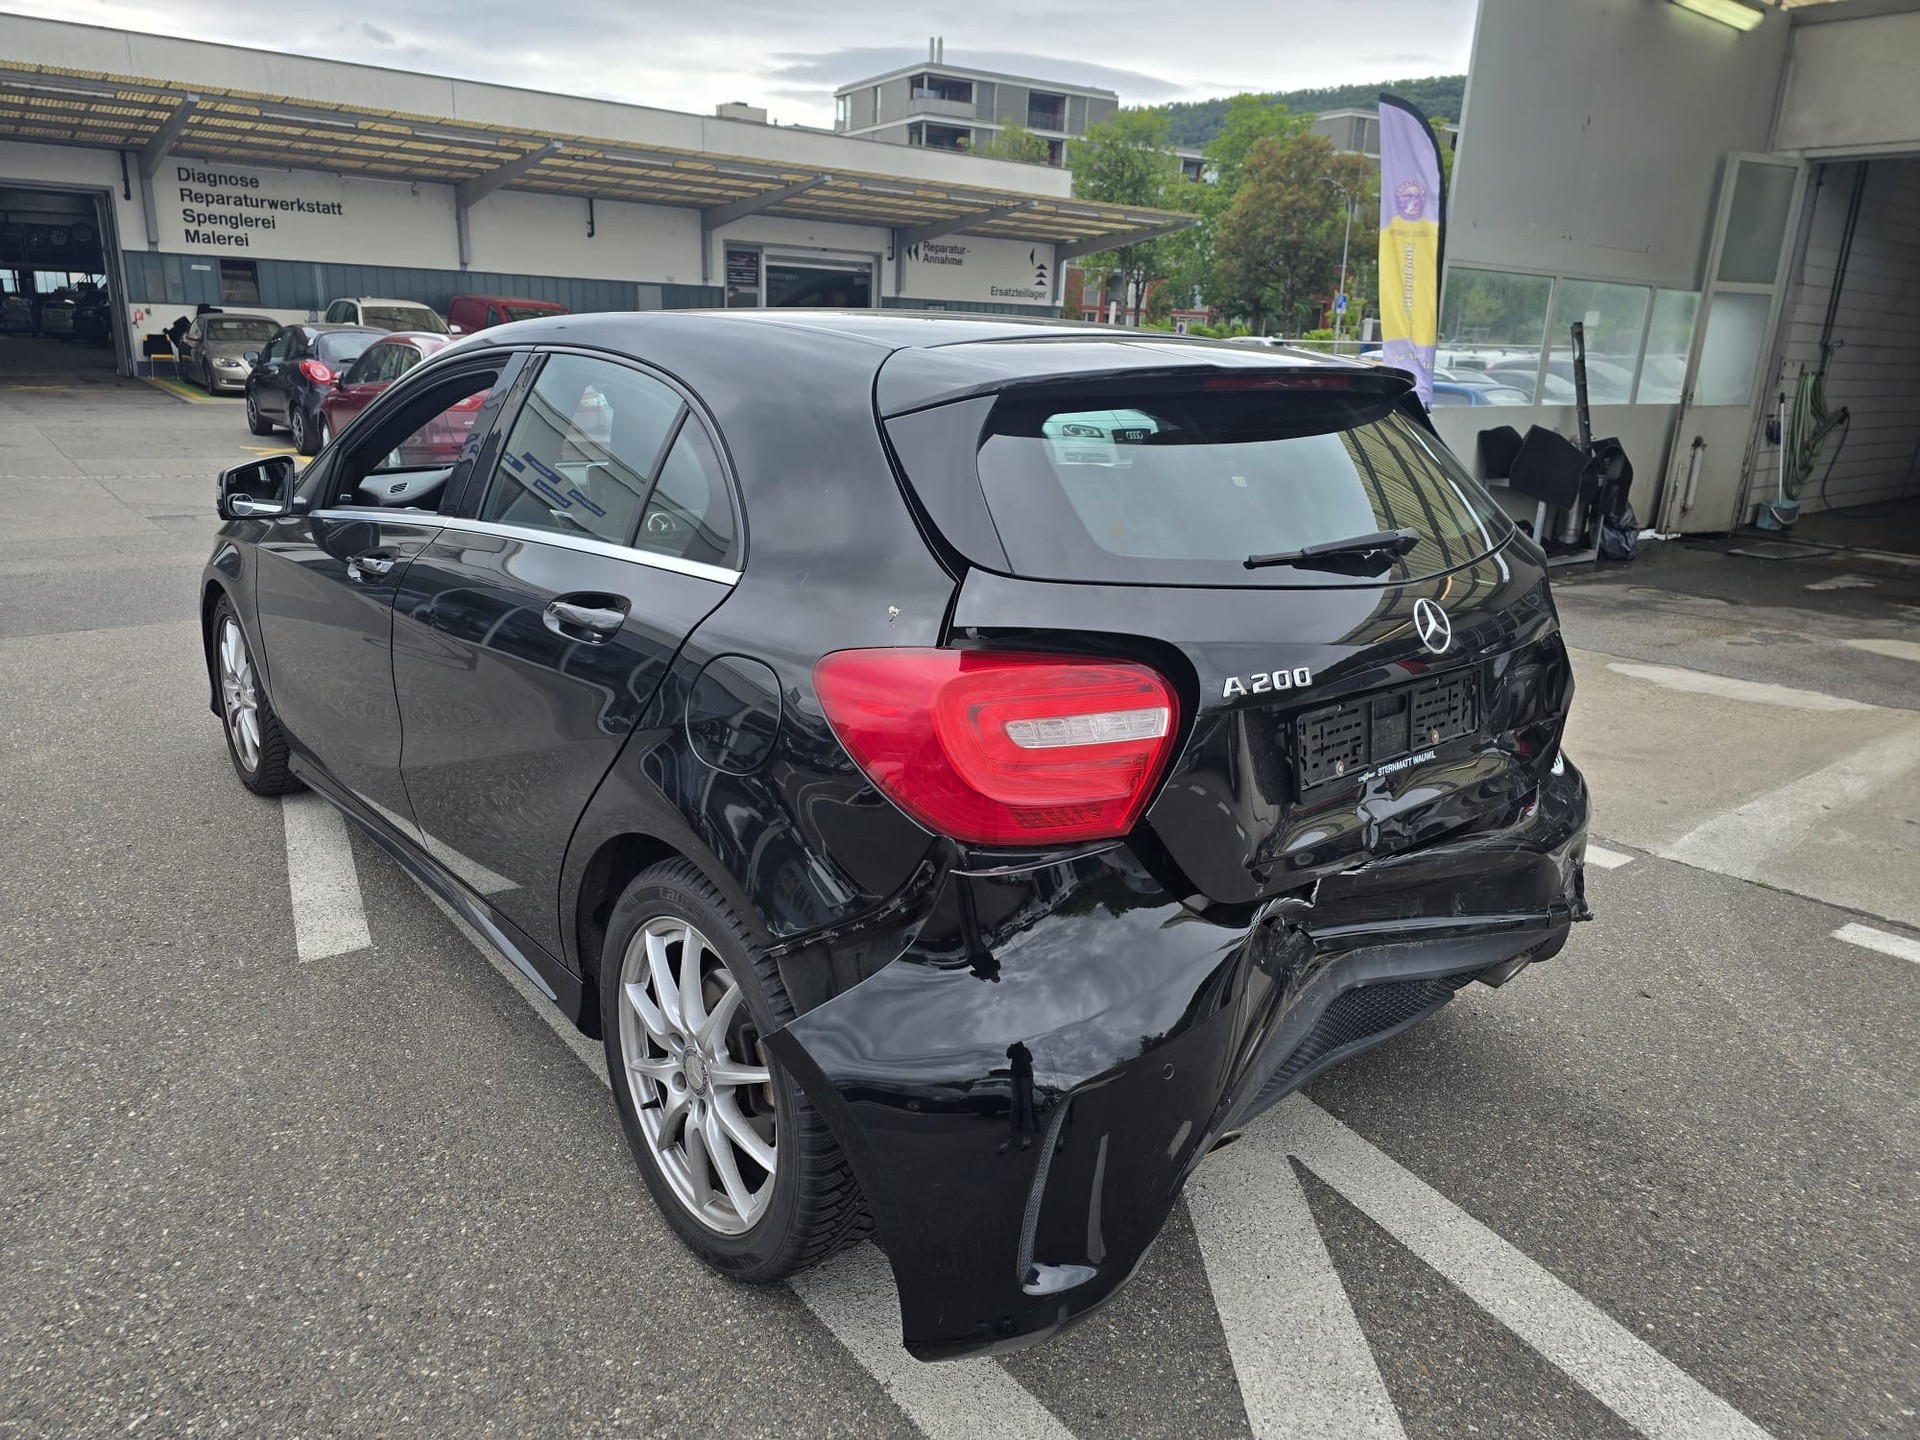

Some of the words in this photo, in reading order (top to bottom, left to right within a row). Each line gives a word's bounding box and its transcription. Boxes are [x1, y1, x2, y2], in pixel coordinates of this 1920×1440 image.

[177, 166, 259, 188] Diagnose
[179, 187, 343, 215] Reparaturwerkstatt
[182, 208, 276, 229] Spenglerei
[184, 229, 249, 247] Malerei
[922, 241, 971, 255] Reparatur-
[922, 253, 963, 266] Annahme
[990, 285, 1047, 300] Ersatzteillager
[1222, 676, 1248, 698] A
[1250, 667, 1313, 694] 200
[1377, 757, 1412, 777] STERNMATT
